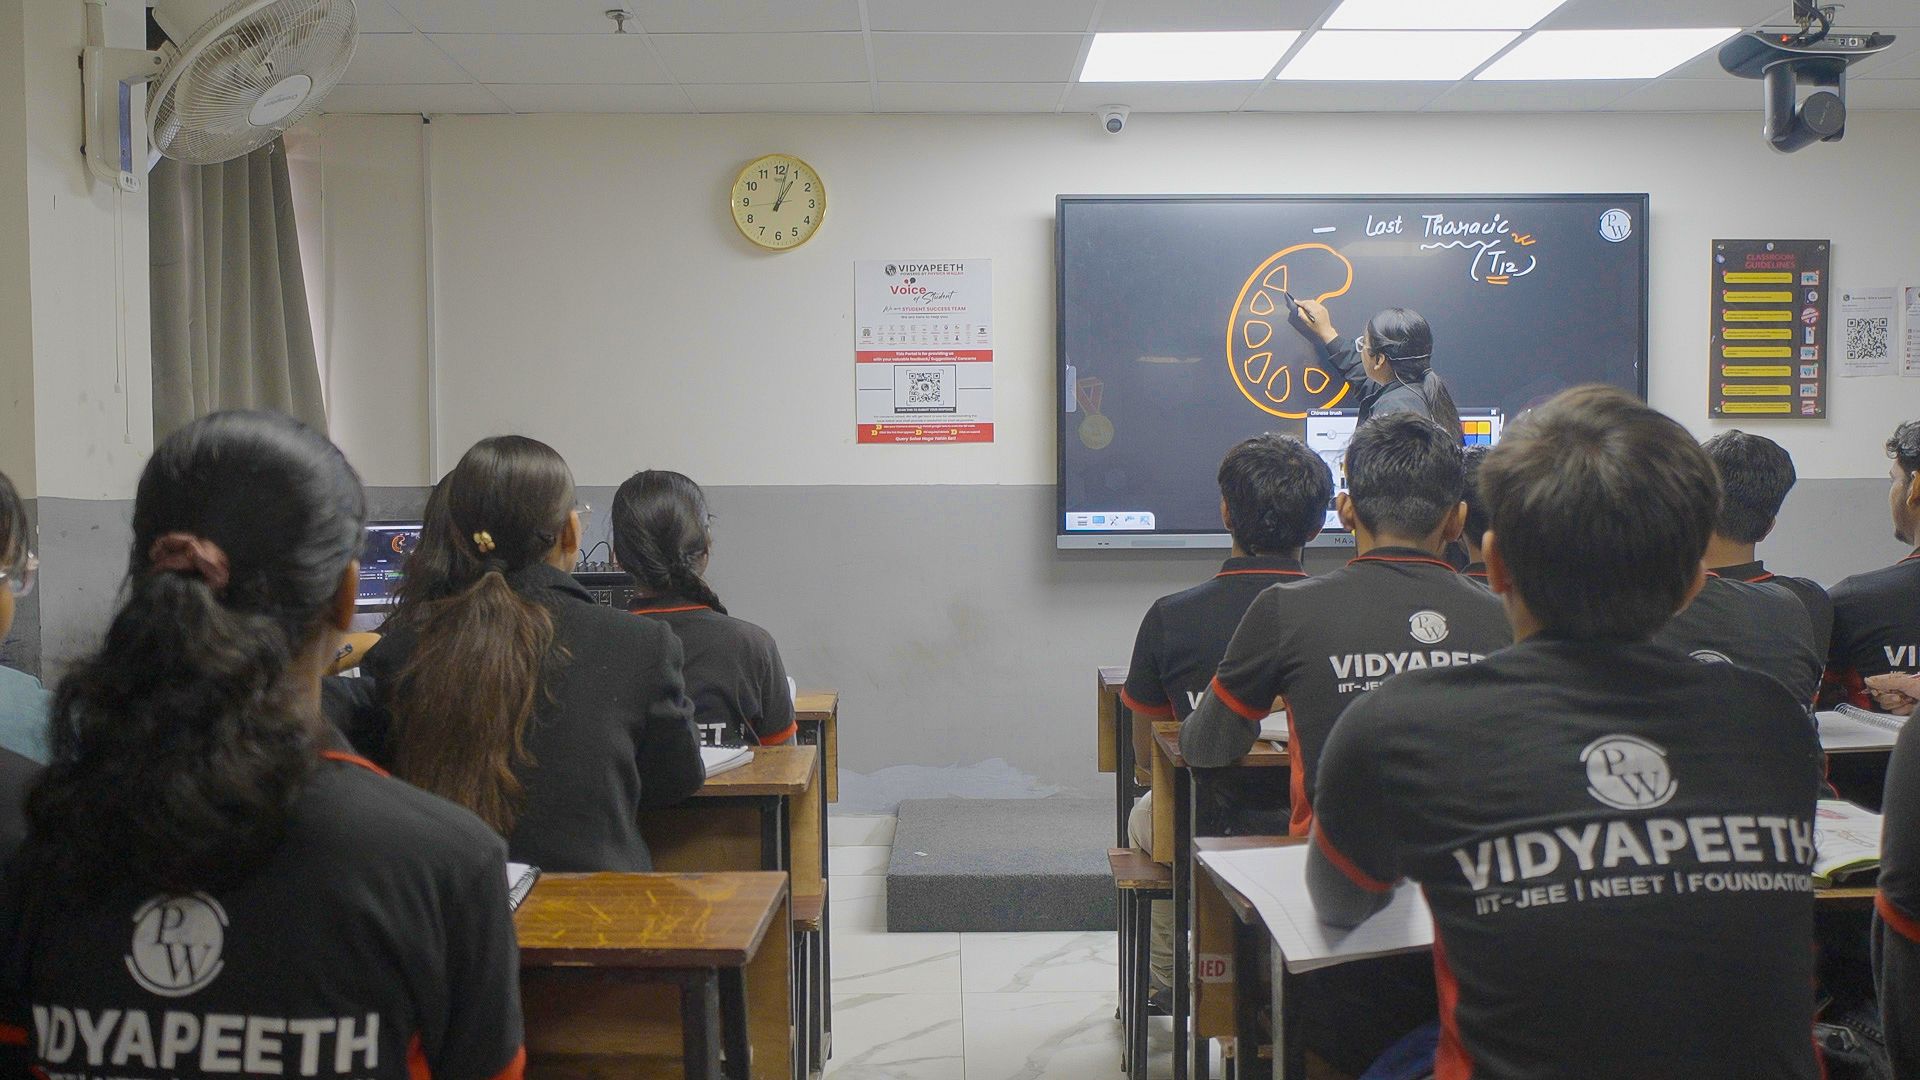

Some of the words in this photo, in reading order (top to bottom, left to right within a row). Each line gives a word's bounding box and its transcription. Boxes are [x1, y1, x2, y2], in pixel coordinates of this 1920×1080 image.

[759, 170, 768, 179] 11
[774, 166, 785, 175] 12
[794, 170, 798, 179] 1
[746, 181, 757, 191] 10
[804, 183, 811, 192] 2
[743, 197, 749, 207] 9
[808, 199, 815, 208] 3
[747, 214, 753, 223] 8
[803, 215, 810, 224] 4
[1366, 214, 1403, 236] Last
[759, 226, 766, 235] 7
[791, 227, 798, 236] 5
[775, 231, 782, 240] 6
[898, 263, 964, 272] VIDYAPEETH
[890, 284, 927, 295] Voice
[922, 291, 958, 305] Student
[1883, 645, 1920, 667] VI
[1338, 681, 1384, 693] IIT-JE
[1453, 815, 1815, 891] VIDYAPEETH
[1475, 884, 1568, 916] IIT-JEE
[1589, 875, 1665, 898] NEET
